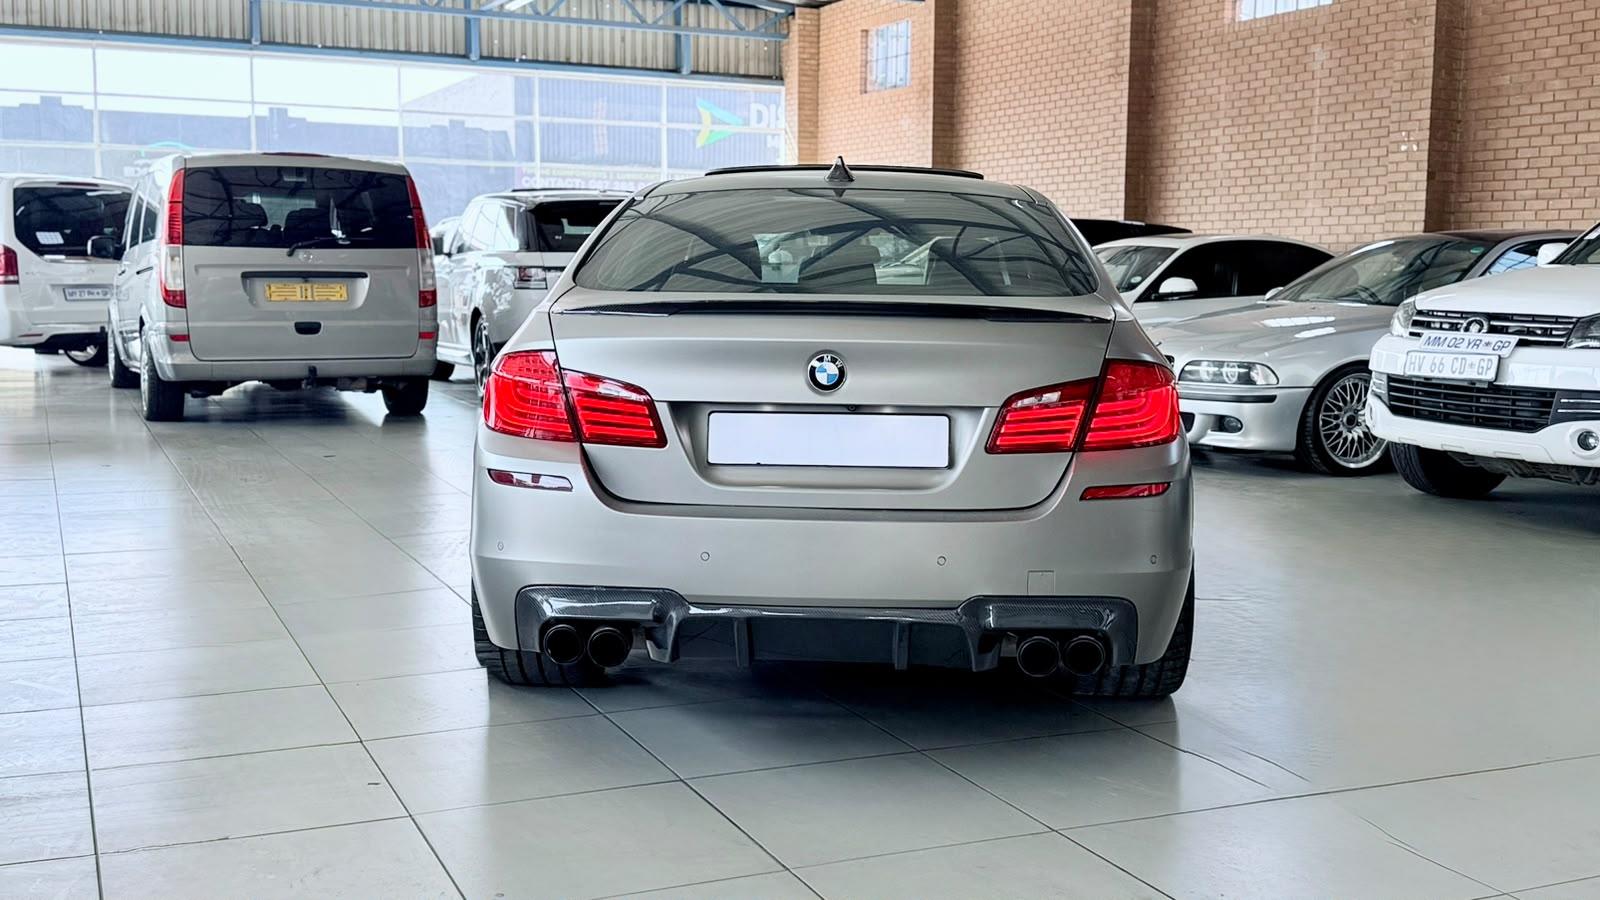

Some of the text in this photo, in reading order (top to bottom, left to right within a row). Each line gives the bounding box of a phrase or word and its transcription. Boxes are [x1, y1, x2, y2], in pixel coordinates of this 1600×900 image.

[1424, 336, 1512, 352] MM 02 YR GP
[1409, 355, 1494, 376] HV 66 CD GP
